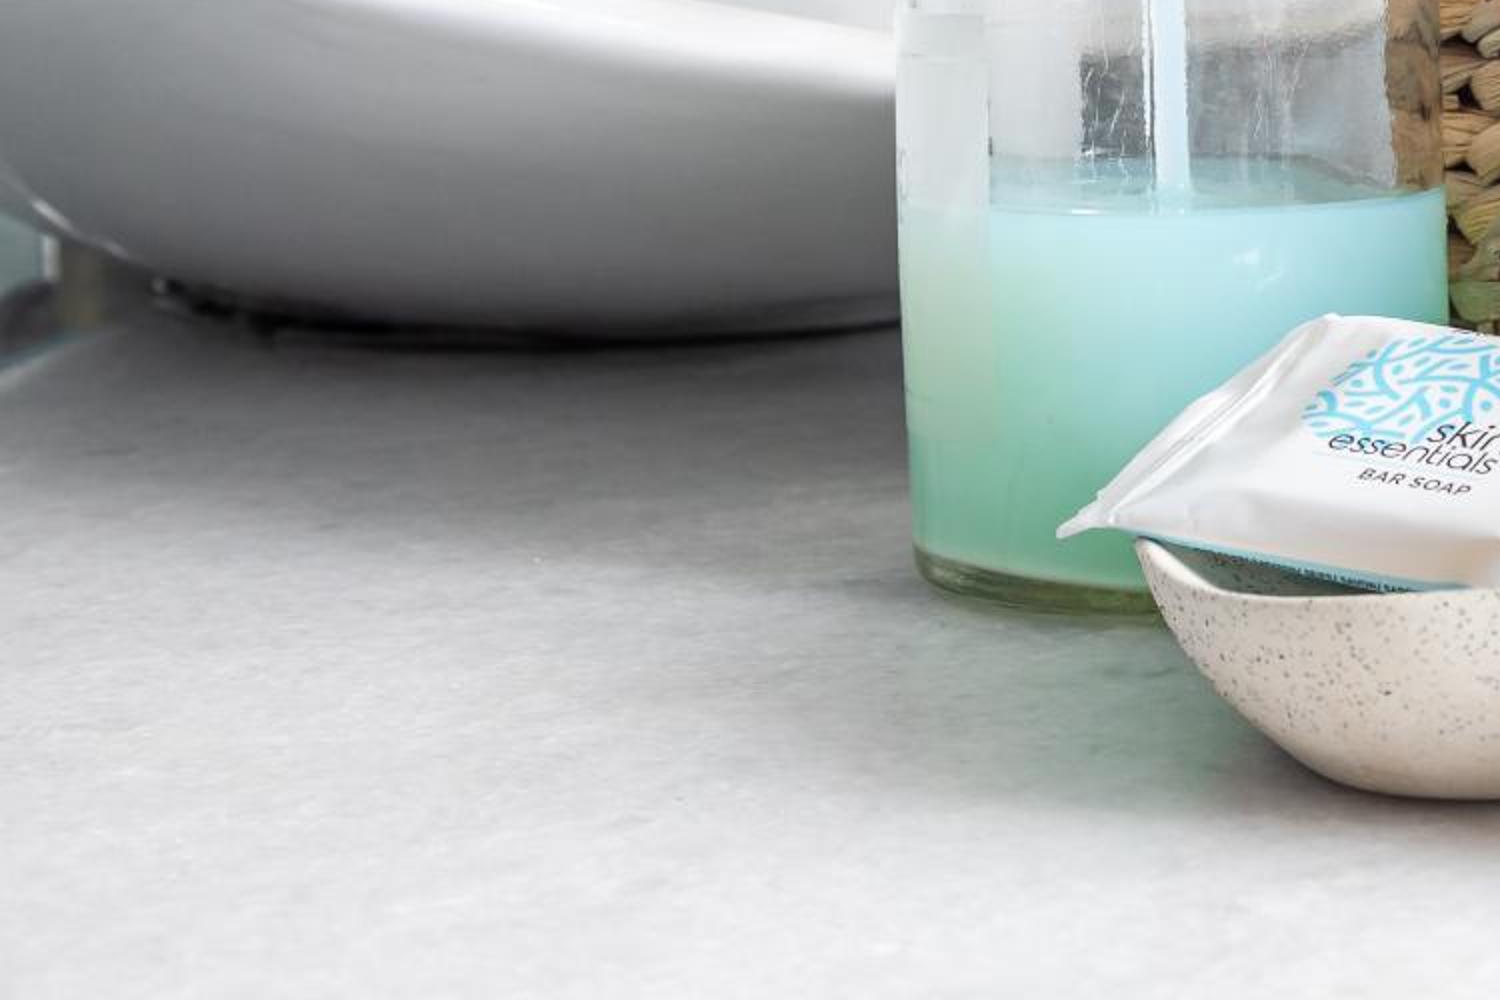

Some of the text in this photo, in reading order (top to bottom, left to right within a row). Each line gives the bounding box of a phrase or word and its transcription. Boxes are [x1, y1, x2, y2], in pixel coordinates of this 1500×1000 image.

[1328, 433, 1499, 475] essentials
[1358, 467, 1473, 497] BAR SOAP
